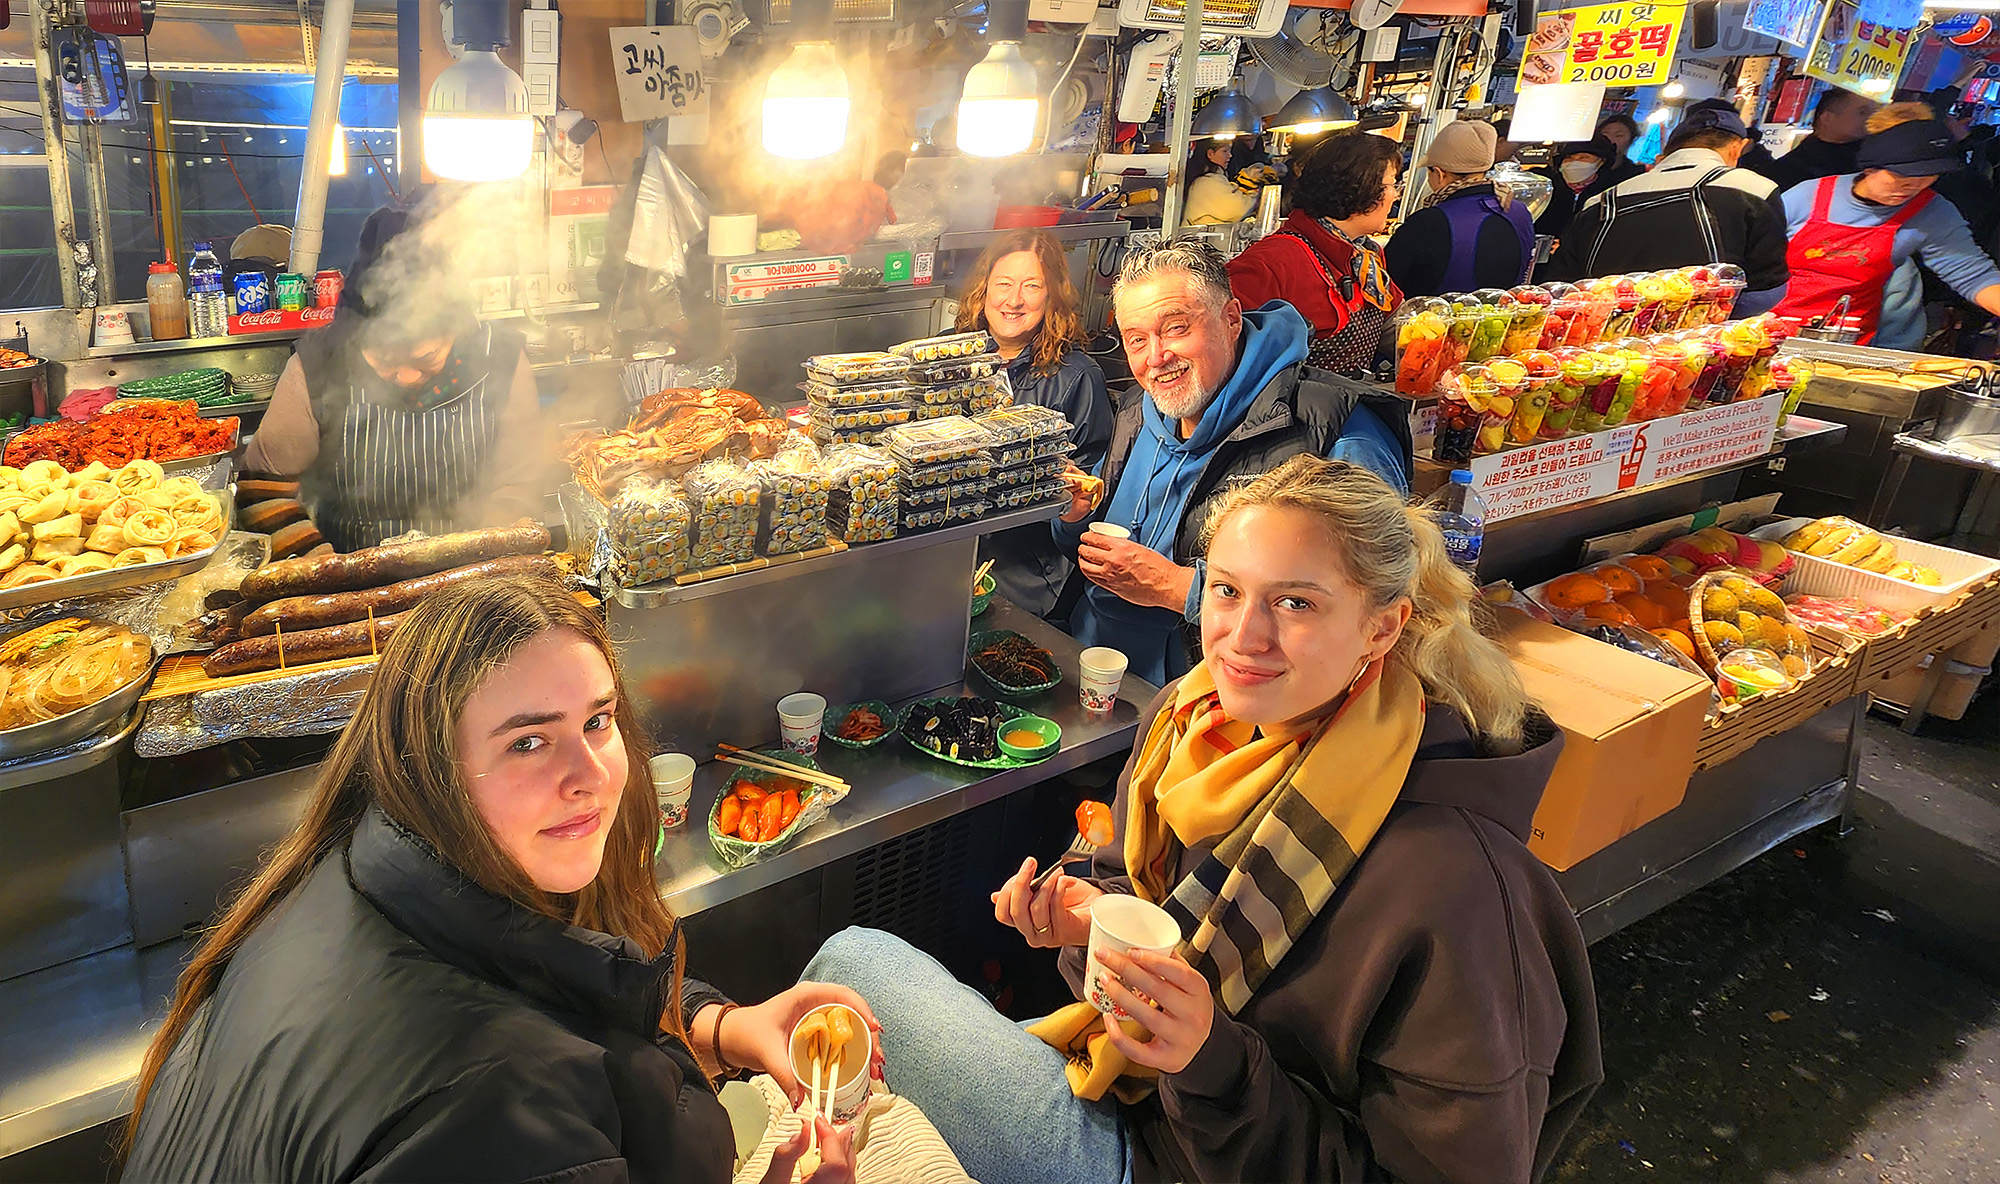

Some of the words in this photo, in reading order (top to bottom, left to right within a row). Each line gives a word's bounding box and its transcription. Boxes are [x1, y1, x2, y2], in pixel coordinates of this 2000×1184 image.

[1572, 23, 1674, 64] 꿀호떡
[622, 43, 665, 75] 고씨
[764, 265, 781, 276] FOIL
[782, 263, 816, 275] COOKING
[276, 280, 306, 298] prit
[1680, 414, 1703, 427] Please
[1703, 410, 1726, 422] Select
[1732, 404, 1750, 417] Fruit
[1750, 402, 1764, 413] Cup
[1682, 429, 1703, 443] Make
[1709, 423, 1730, 437] Fresh
[1729, 420, 1749, 435] Juice
[1501, 448, 1537, 468] 과일컵을
[1538, 442, 1565, 461] 선택해
[1567, 437, 1593, 453] 주세요
[1482, 470, 1510, 488] 시원한
[1511, 463, 1538, 481] 주스로
[1540, 457, 1568, 475] 만들어
[1568, 449, 1603, 468] 드립니다
